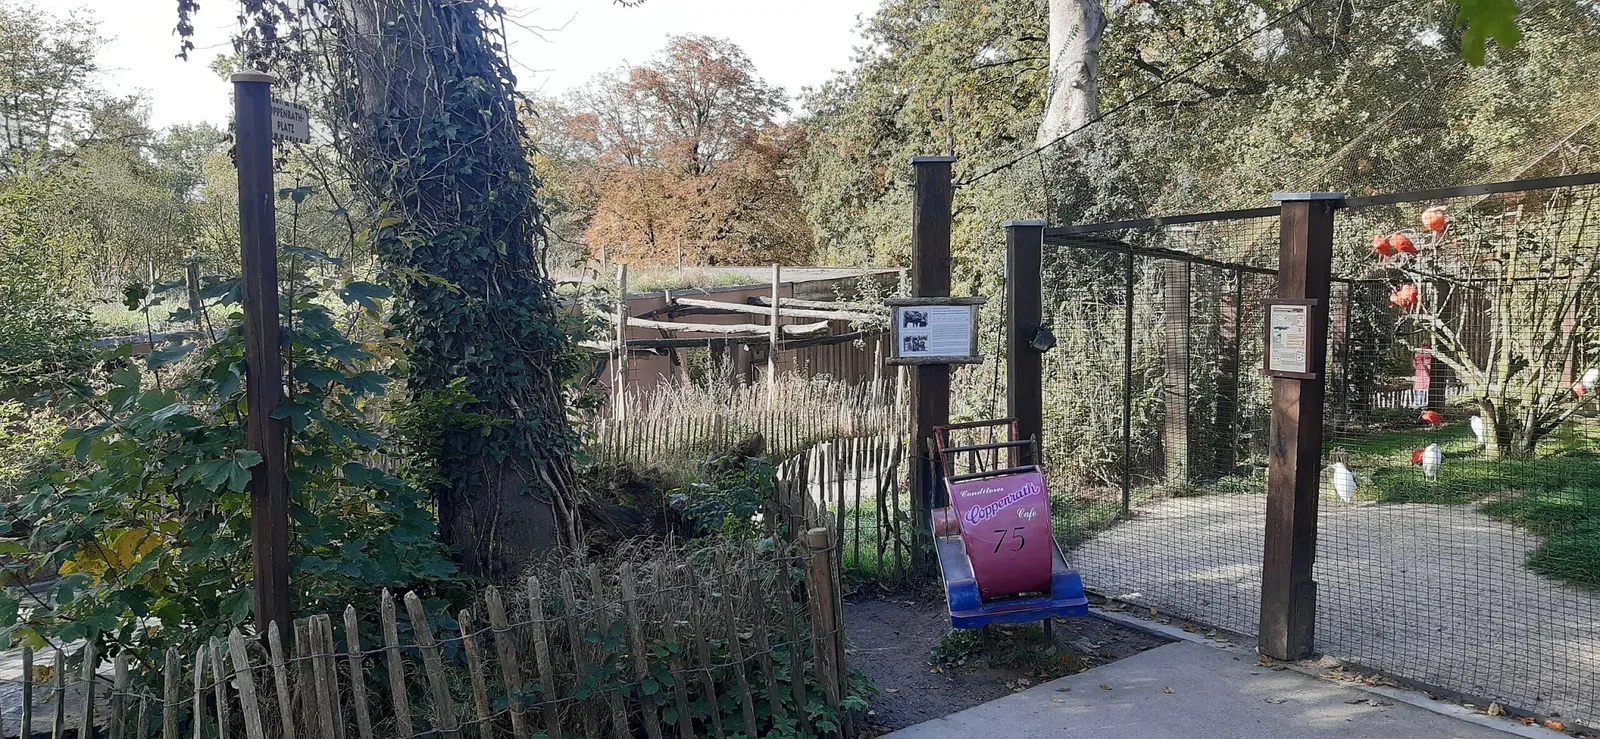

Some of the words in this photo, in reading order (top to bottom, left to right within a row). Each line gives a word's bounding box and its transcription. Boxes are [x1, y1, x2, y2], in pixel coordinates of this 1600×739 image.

[272, 106, 304, 123] PPENRATH-
[277, 120, 295, 133] PLATZ
[965, 482, 1040, 525] Coppenrath
[993, 526, 1025, 554] 75
